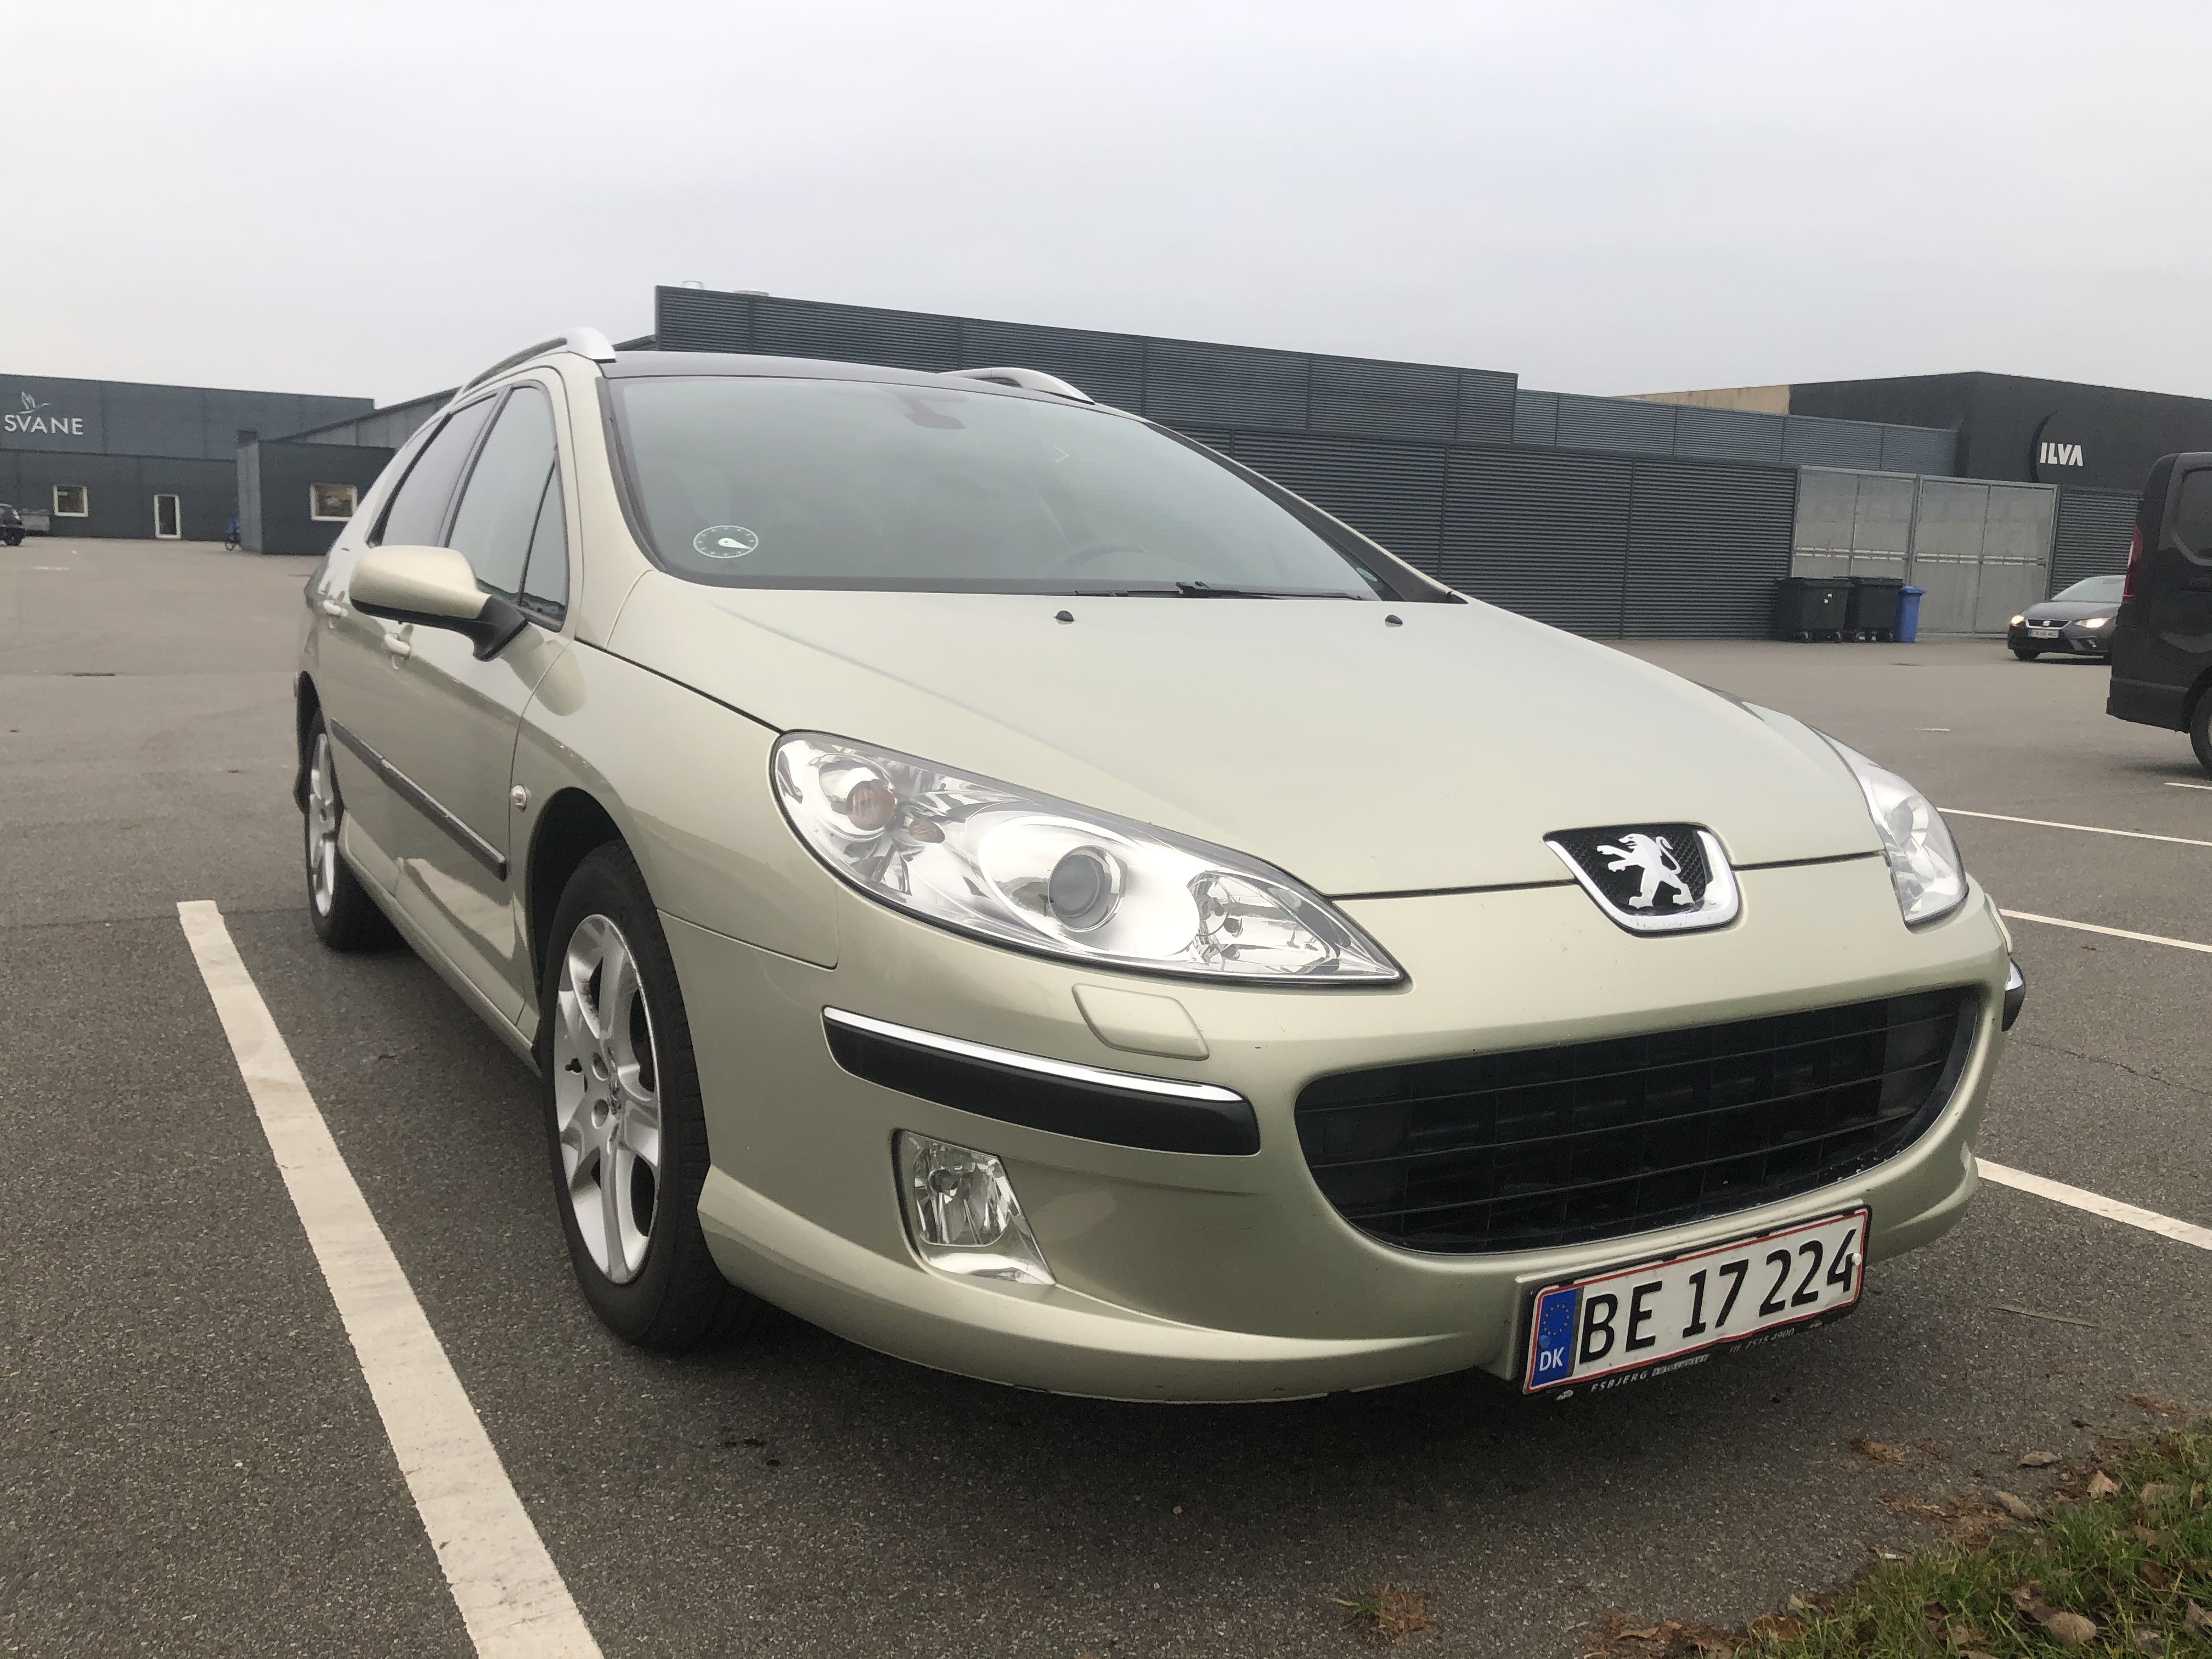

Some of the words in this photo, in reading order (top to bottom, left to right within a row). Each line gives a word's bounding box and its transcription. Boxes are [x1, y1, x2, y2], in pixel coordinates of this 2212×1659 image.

[4, 414, 84, 436] SVANE
[2040, 442, 2084, 466] ILVA
[1579, 1280, 1662, 1364] BE
[1682, 1259, 1750, 1339] 17
[1759, 1228, 1858, 1317] 224
[1539, 1347, 1564, 1372] DK
